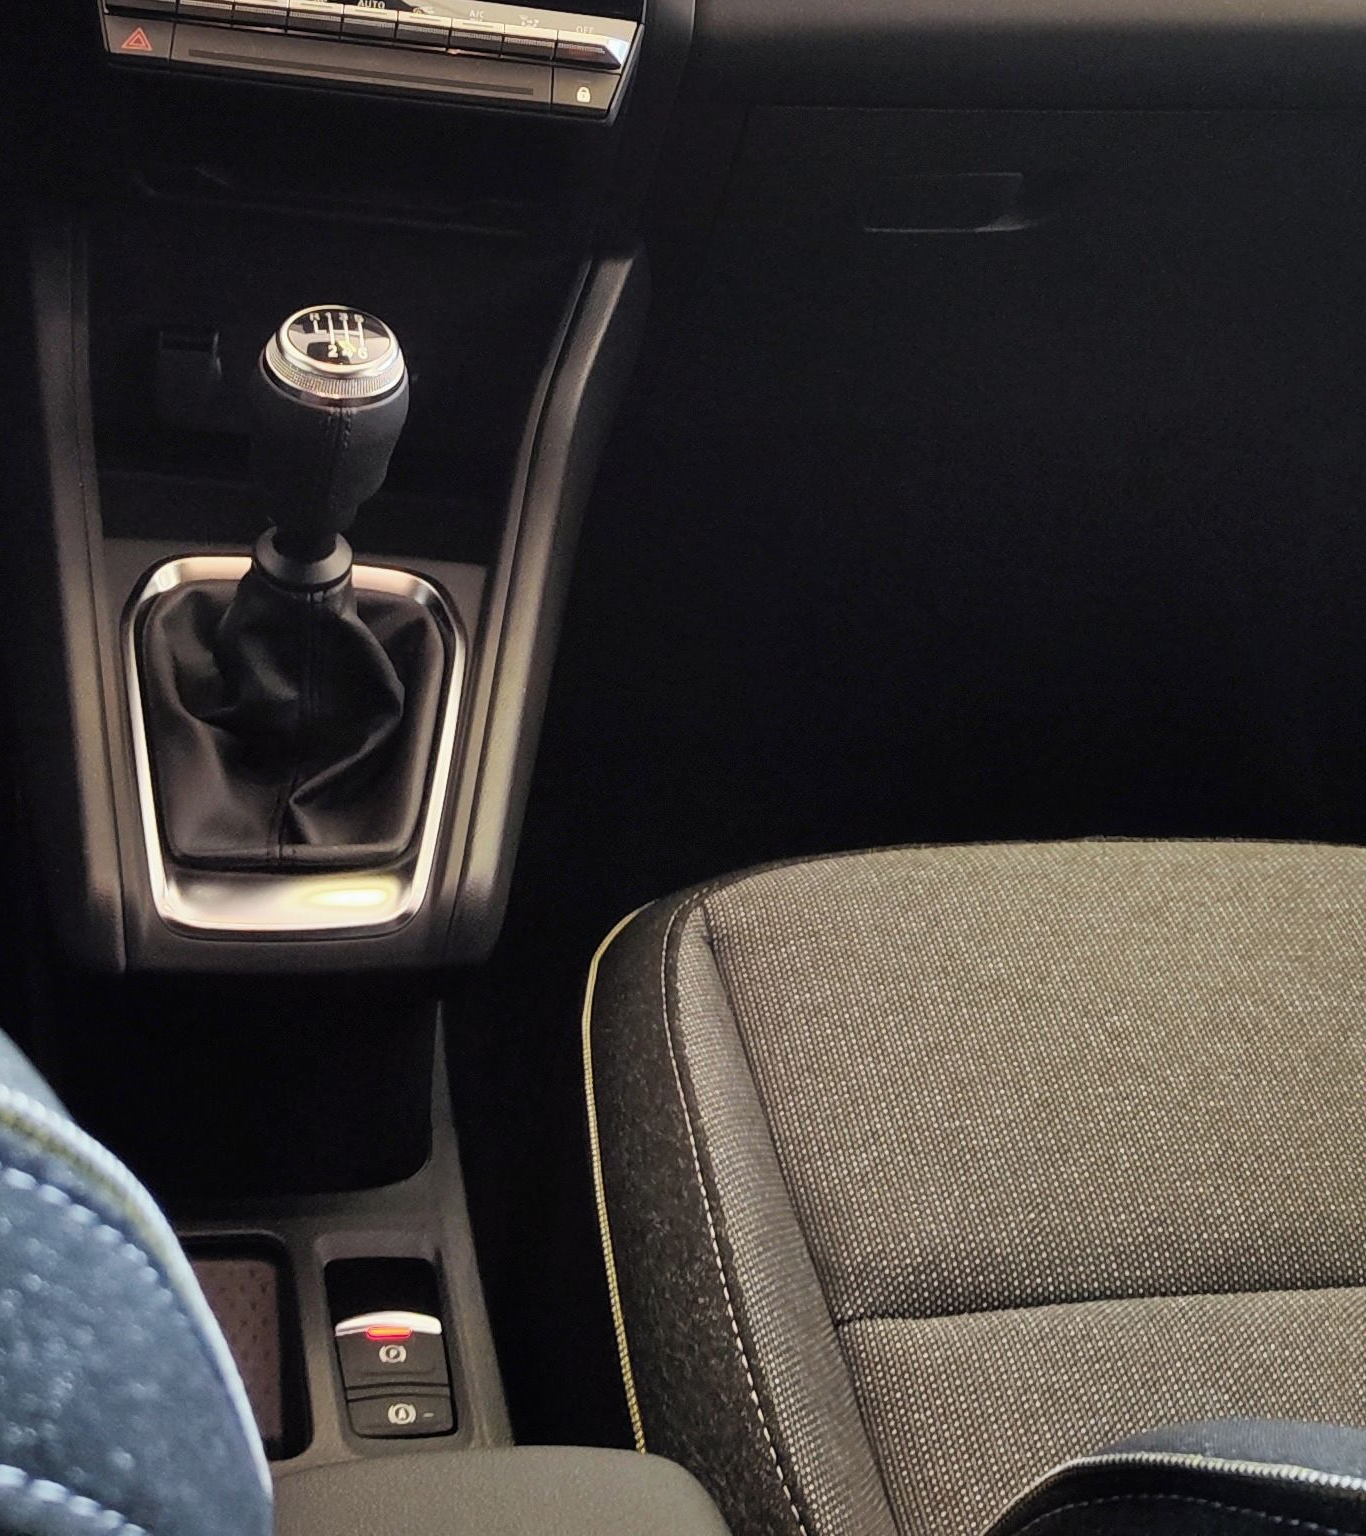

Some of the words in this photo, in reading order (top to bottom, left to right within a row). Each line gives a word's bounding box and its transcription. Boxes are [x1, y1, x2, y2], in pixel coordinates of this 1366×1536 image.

[469, 9, 485, 19] A/C
[327, 344, 339, 358] 2
[357, 346, 369, 360] 6
